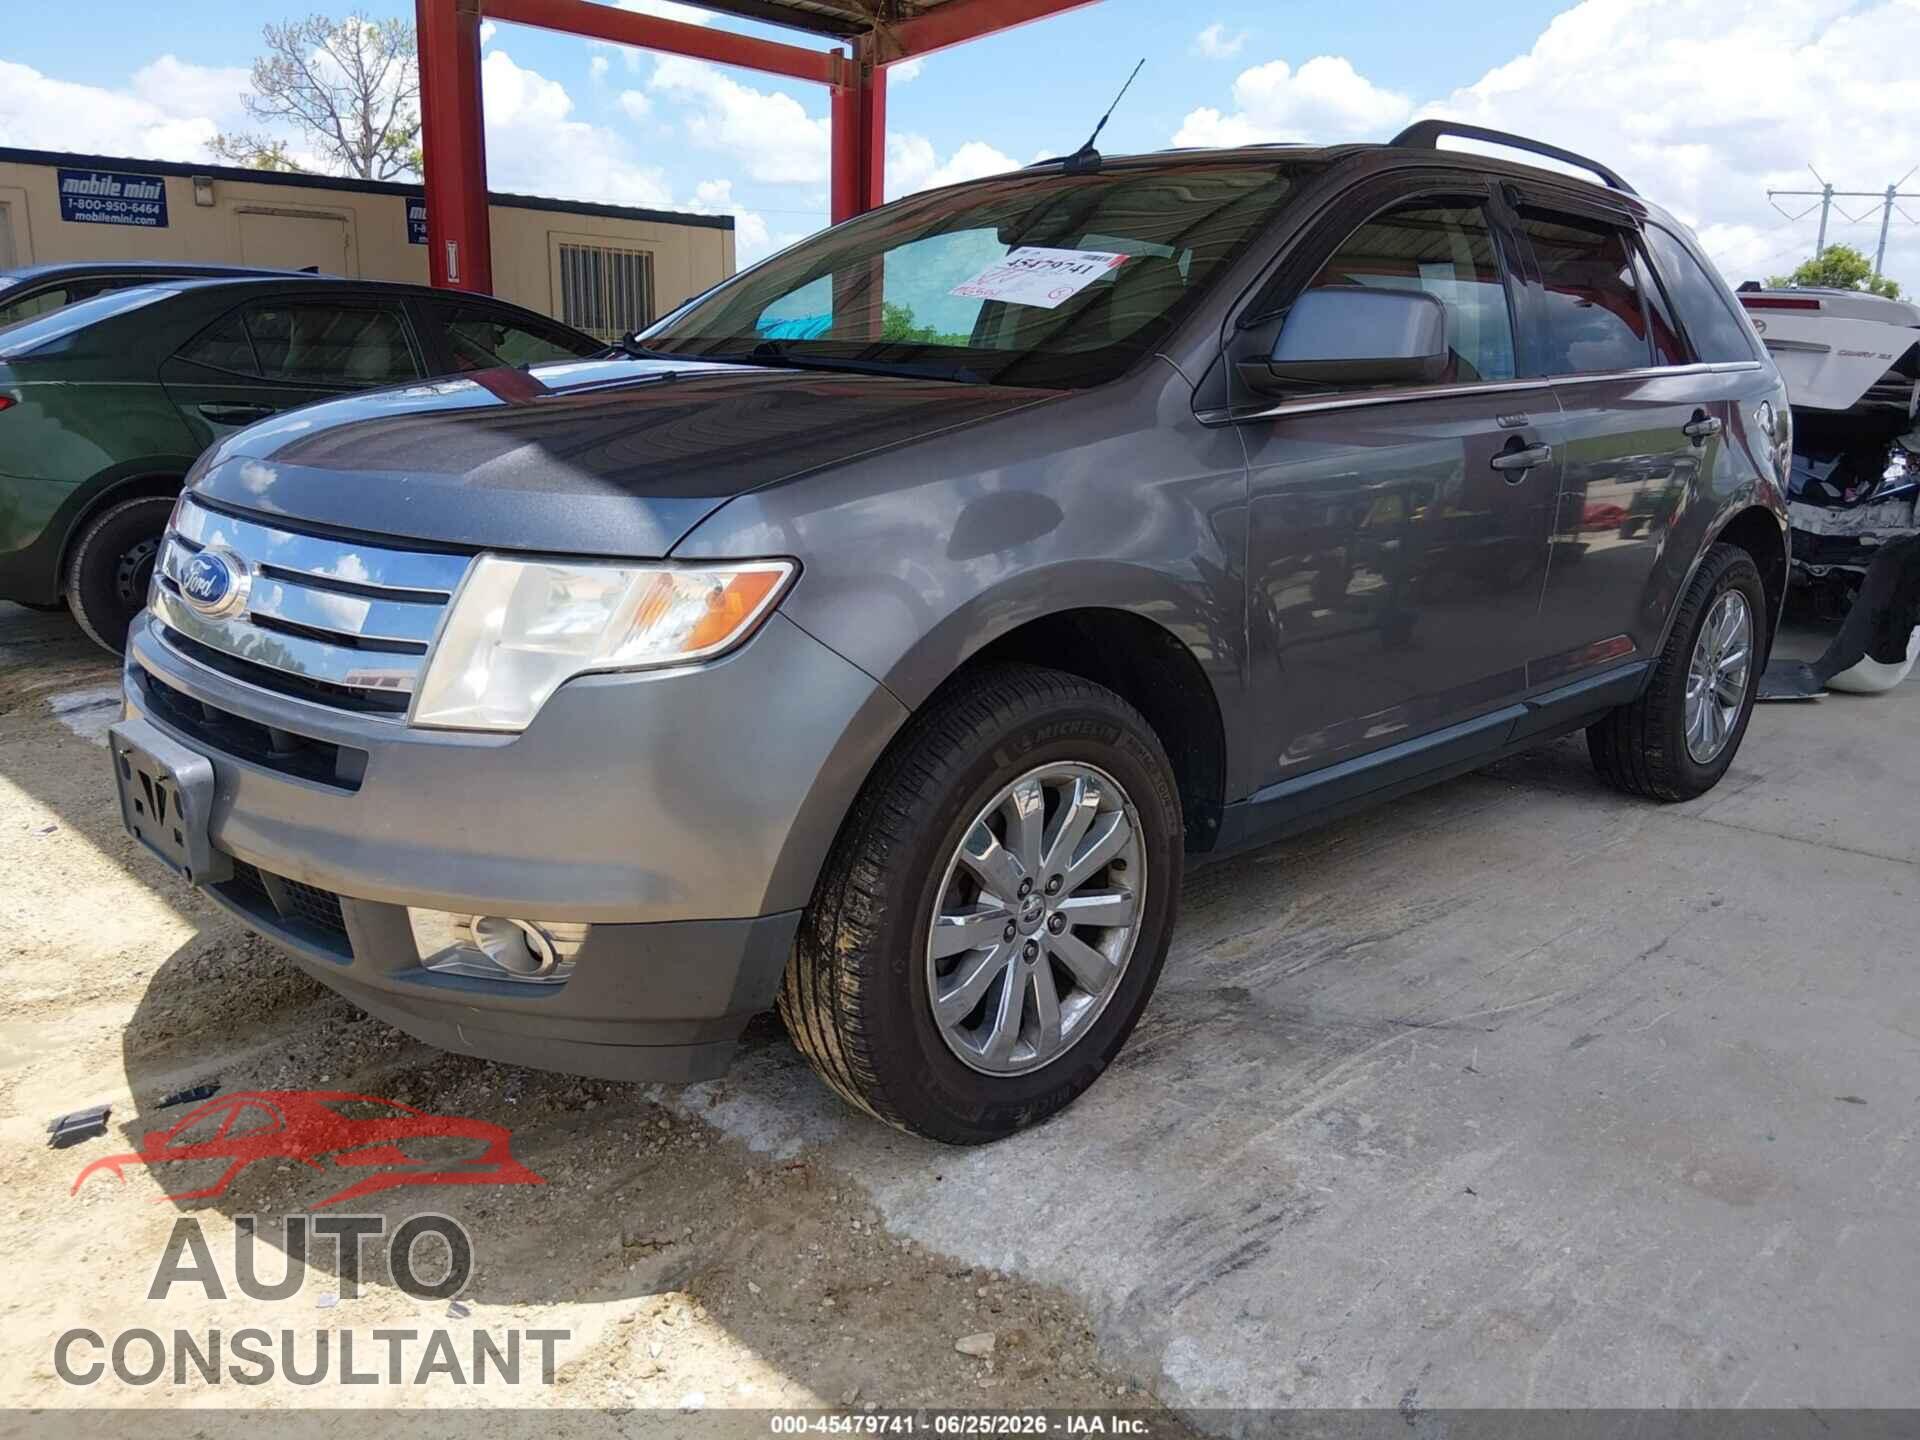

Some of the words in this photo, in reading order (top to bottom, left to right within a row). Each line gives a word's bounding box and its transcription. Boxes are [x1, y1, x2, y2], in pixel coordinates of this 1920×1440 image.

[62, 174, 121, 197] mobile
[123, 182, 163, 200] mini
[68, 199, 160, 215] 1-800-950-6464
[74, 212, 157, 225] mobilemini.com
[184, 560, 217, 598] Ford
[1036, 719, 1121, 744] MICHELIN
